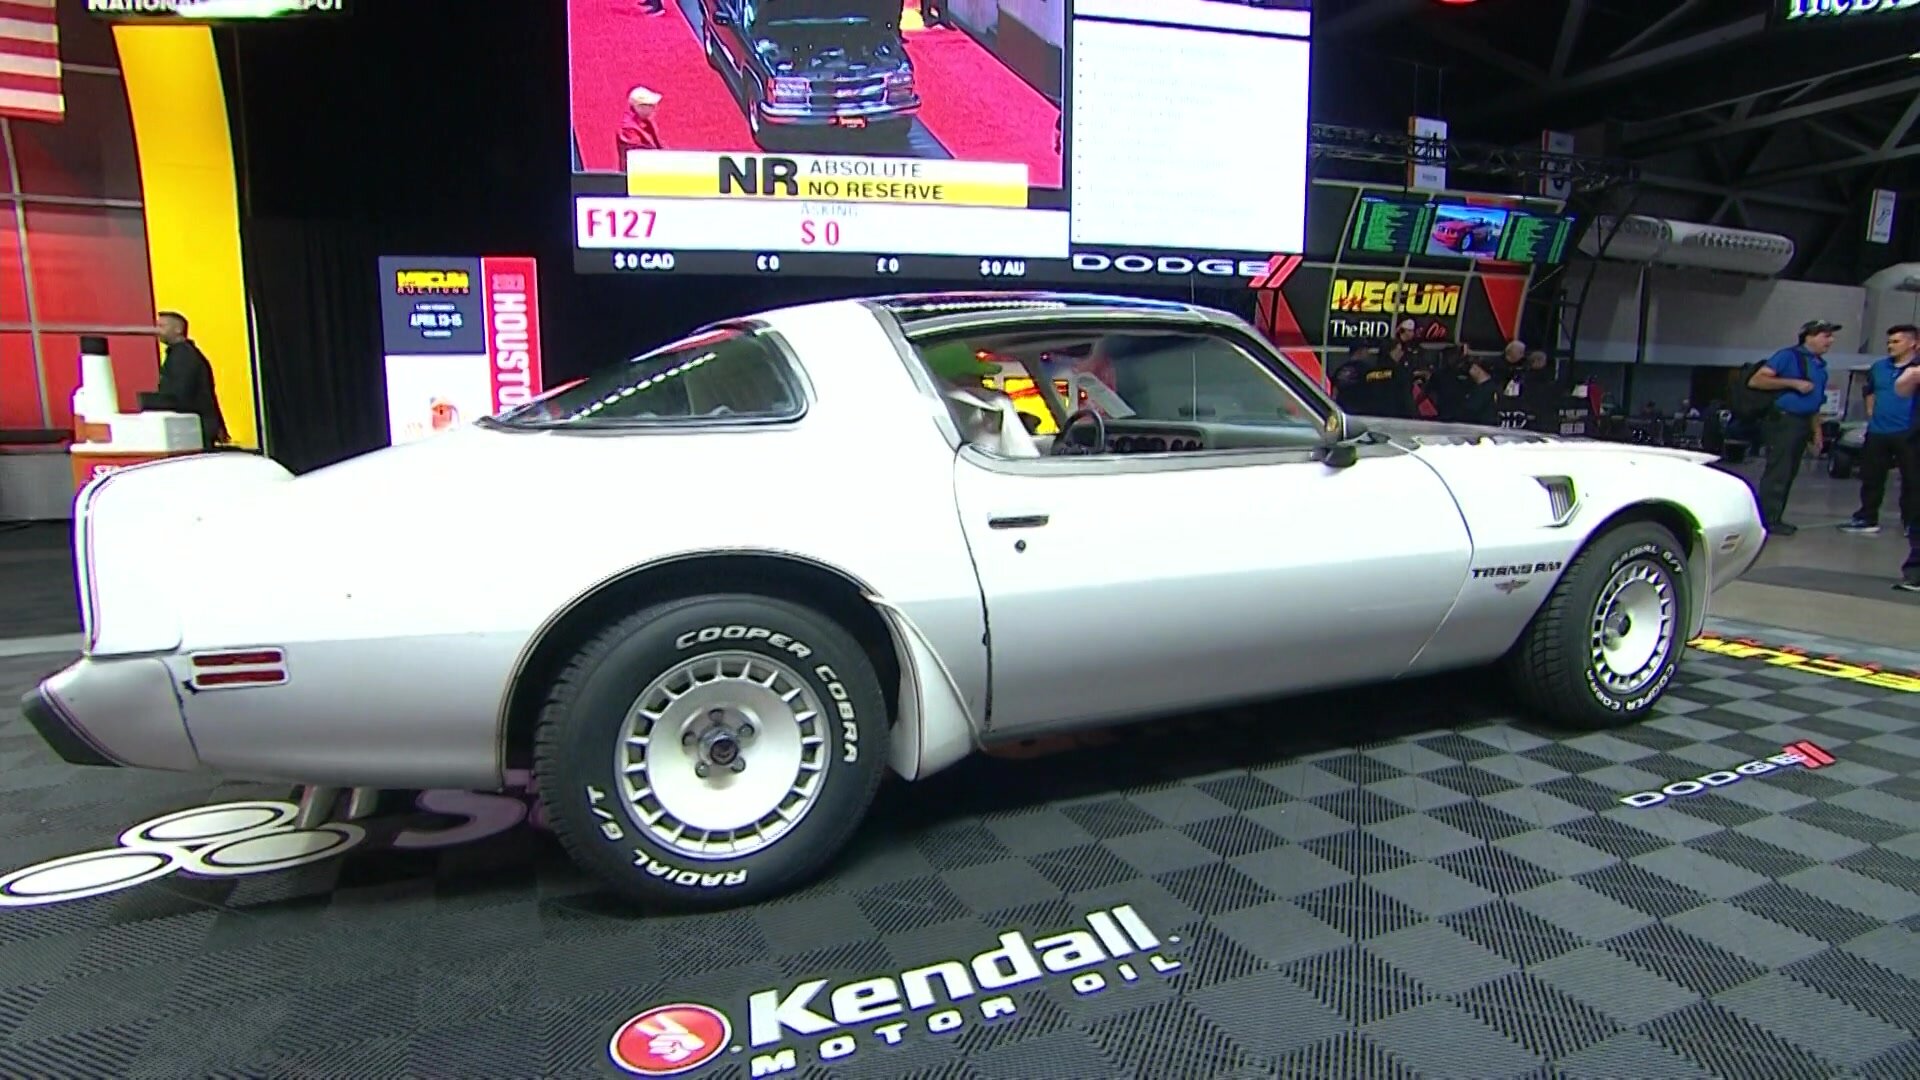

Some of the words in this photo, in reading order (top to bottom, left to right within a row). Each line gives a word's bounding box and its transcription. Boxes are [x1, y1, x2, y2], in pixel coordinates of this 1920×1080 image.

[718, 156, 799, 196] NR
[810, 159, 923, 178] ABSOLUTE
[808, 181, 839, 196] NO
[846, 182, 944, 200] RESERVE
[587, 208, 656, 239] F127
[640, 253, 675, 270] CAD
[1002, 260, 1026, 276] AU
[1071, 252, 1272, 278] DODGE
[1330, 278, 1462, 317] MECUM
[1330, 319, 1358, 338] The
[1359, 320, 1389, 338] BID
[493, 292, 533, 415] HOUSTO
[1472, 563, 1533, 578] TRANS
[675, 624, 812, 658] COOPER
[815, 664, 860, 763] COBRA
[1619, 751, 1808, 808] DODGE
[586, 785, 625, 841] G/T
[631, 848, 748, 887] RADIAL
[749, 903, 1160, 1049] Kendall
[750, 996, 1017, 1079] MOTOR
[1071, 954, 1182, 995] OIL
